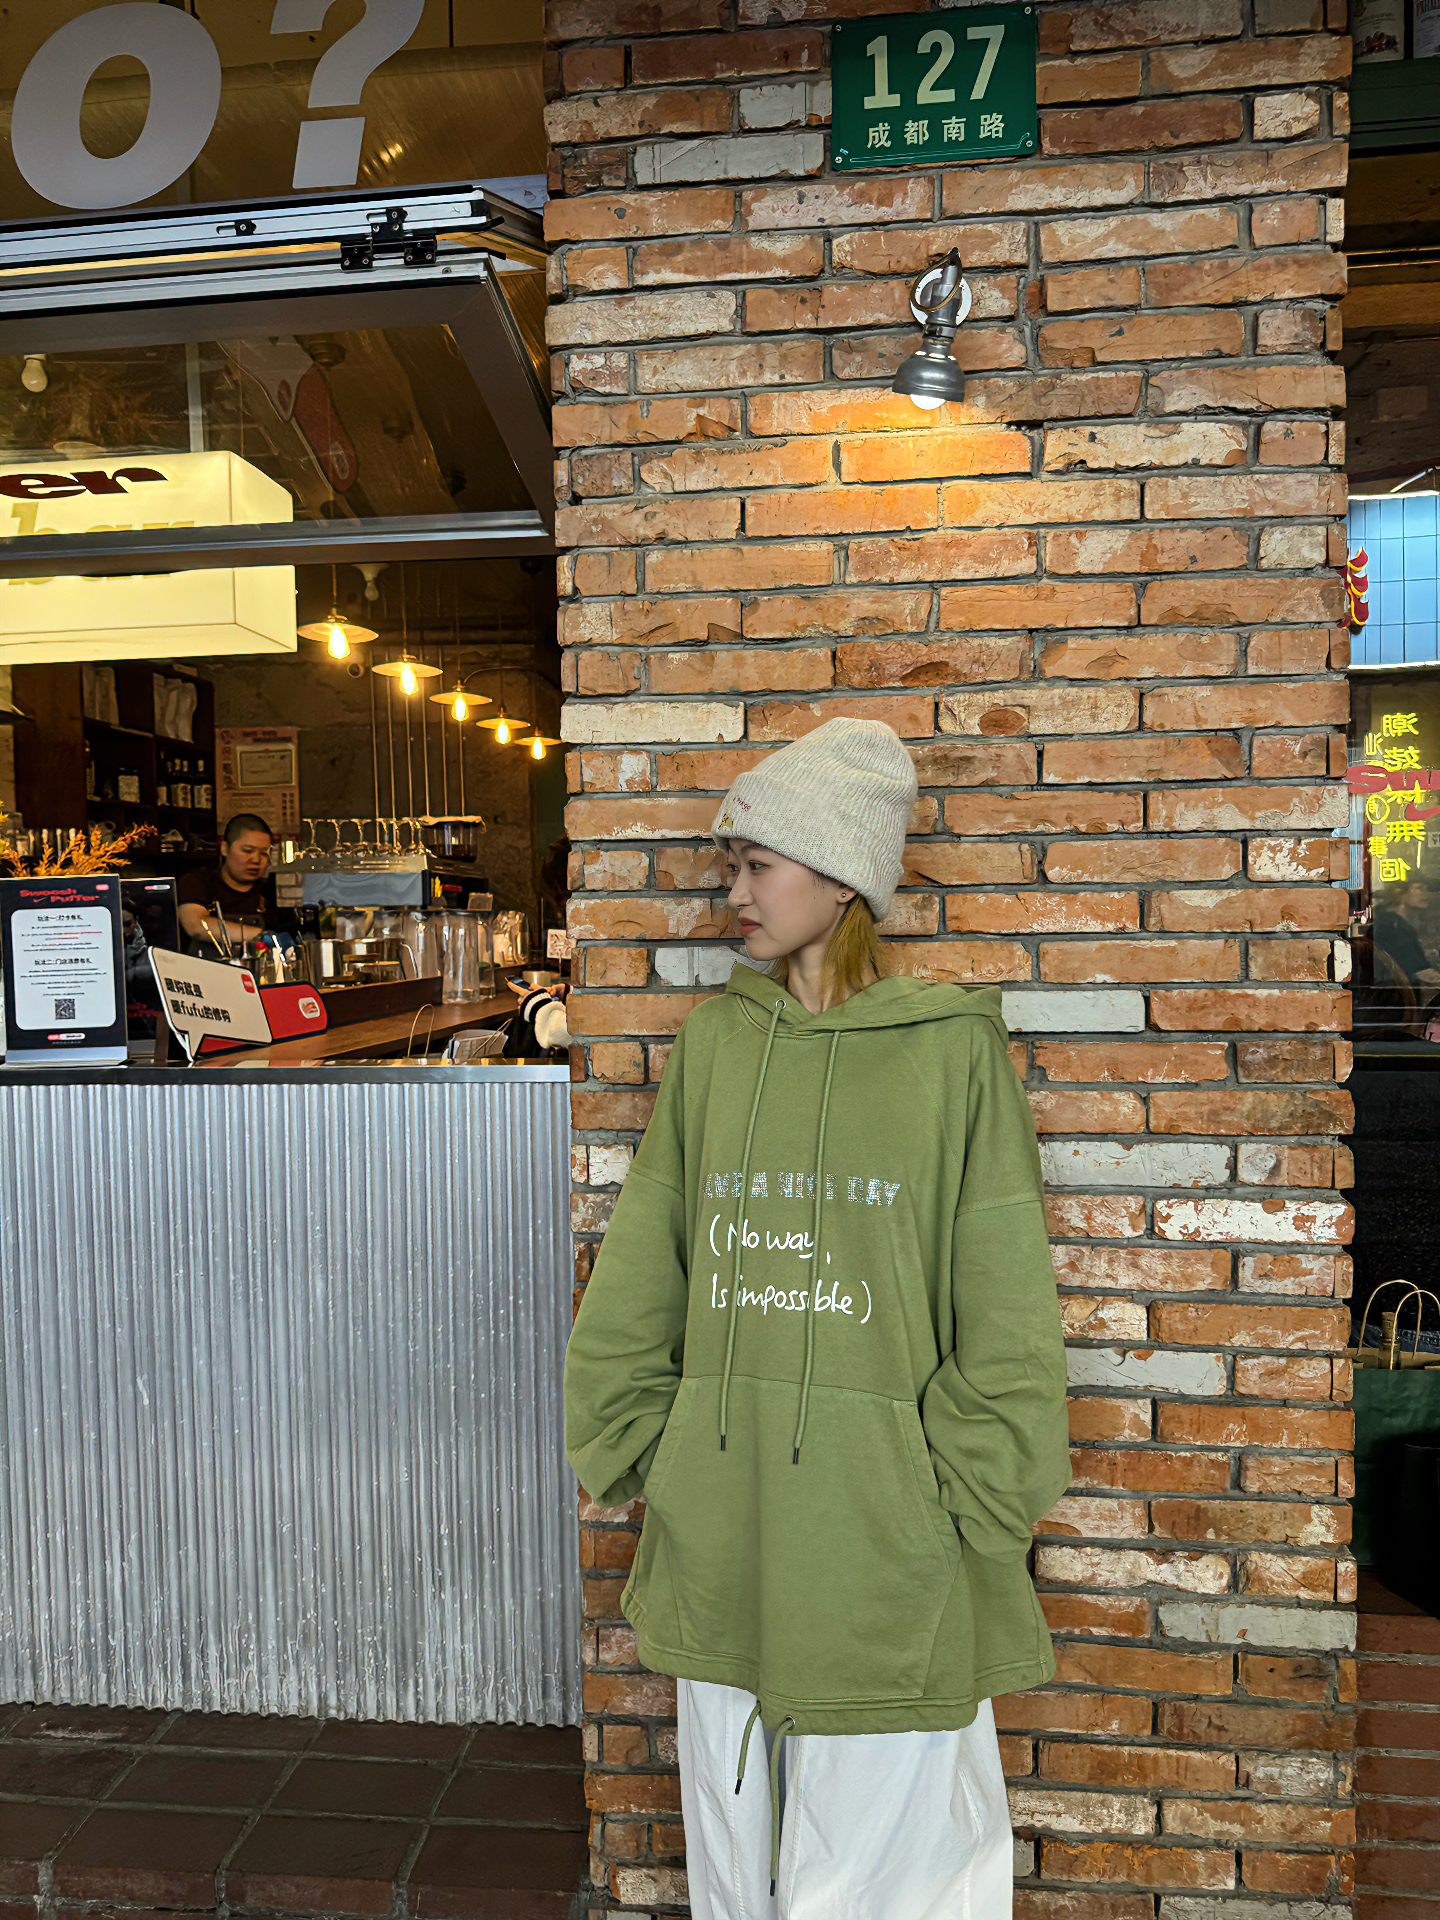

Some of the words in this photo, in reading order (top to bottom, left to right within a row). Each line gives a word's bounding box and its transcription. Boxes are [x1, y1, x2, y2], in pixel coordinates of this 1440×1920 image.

[863, 24, 1005, 110] 127
[866, 112, 1005, 149] 成都南路
[751, 1171, 769, 1198] A
[847, 1176, 901, 1207] DAY
